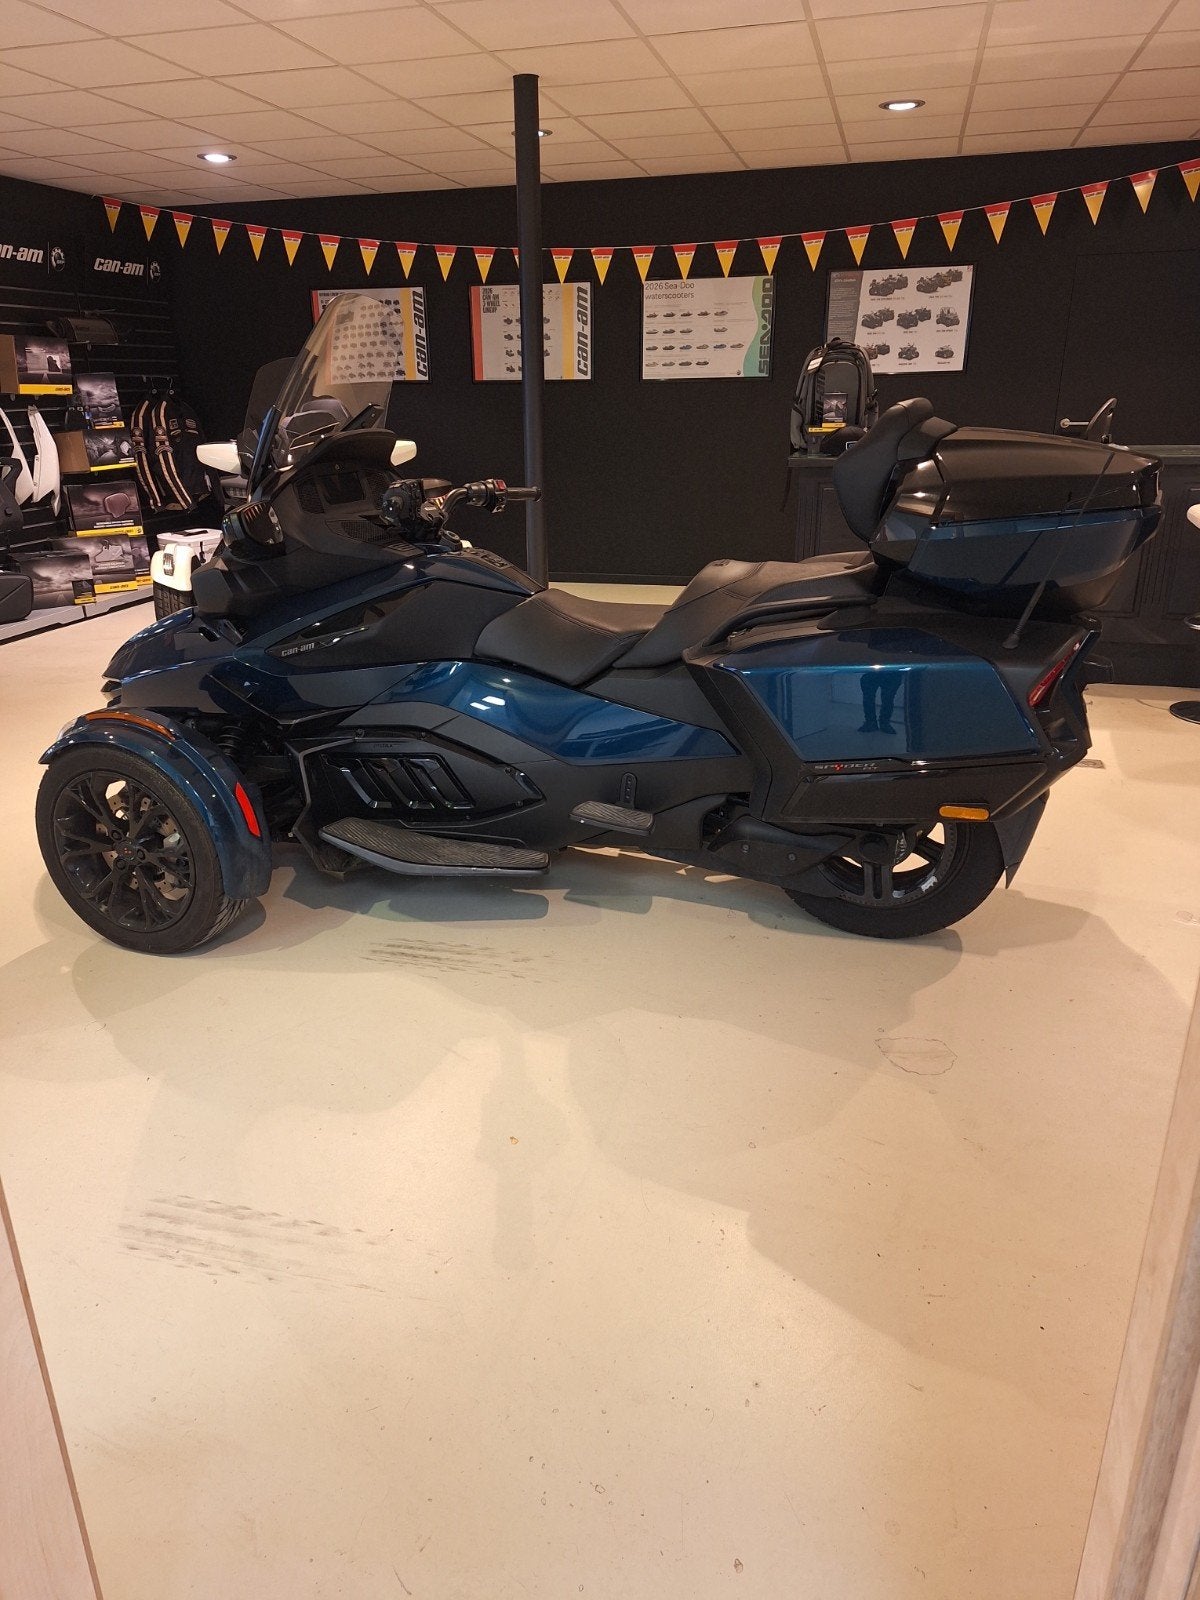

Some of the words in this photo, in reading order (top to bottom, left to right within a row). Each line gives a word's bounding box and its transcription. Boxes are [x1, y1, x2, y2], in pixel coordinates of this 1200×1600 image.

[0, 244, 43, 264] n-am
[94, 257, 144, 277] can-am
[645, 282, 663, 290] 2026
[645, 291, 694, 300] waterscooters
[413, 291, 427, 377] can-am
[576, 286, 588, 377] can-am
[281, 642, 315, 656] can-am
